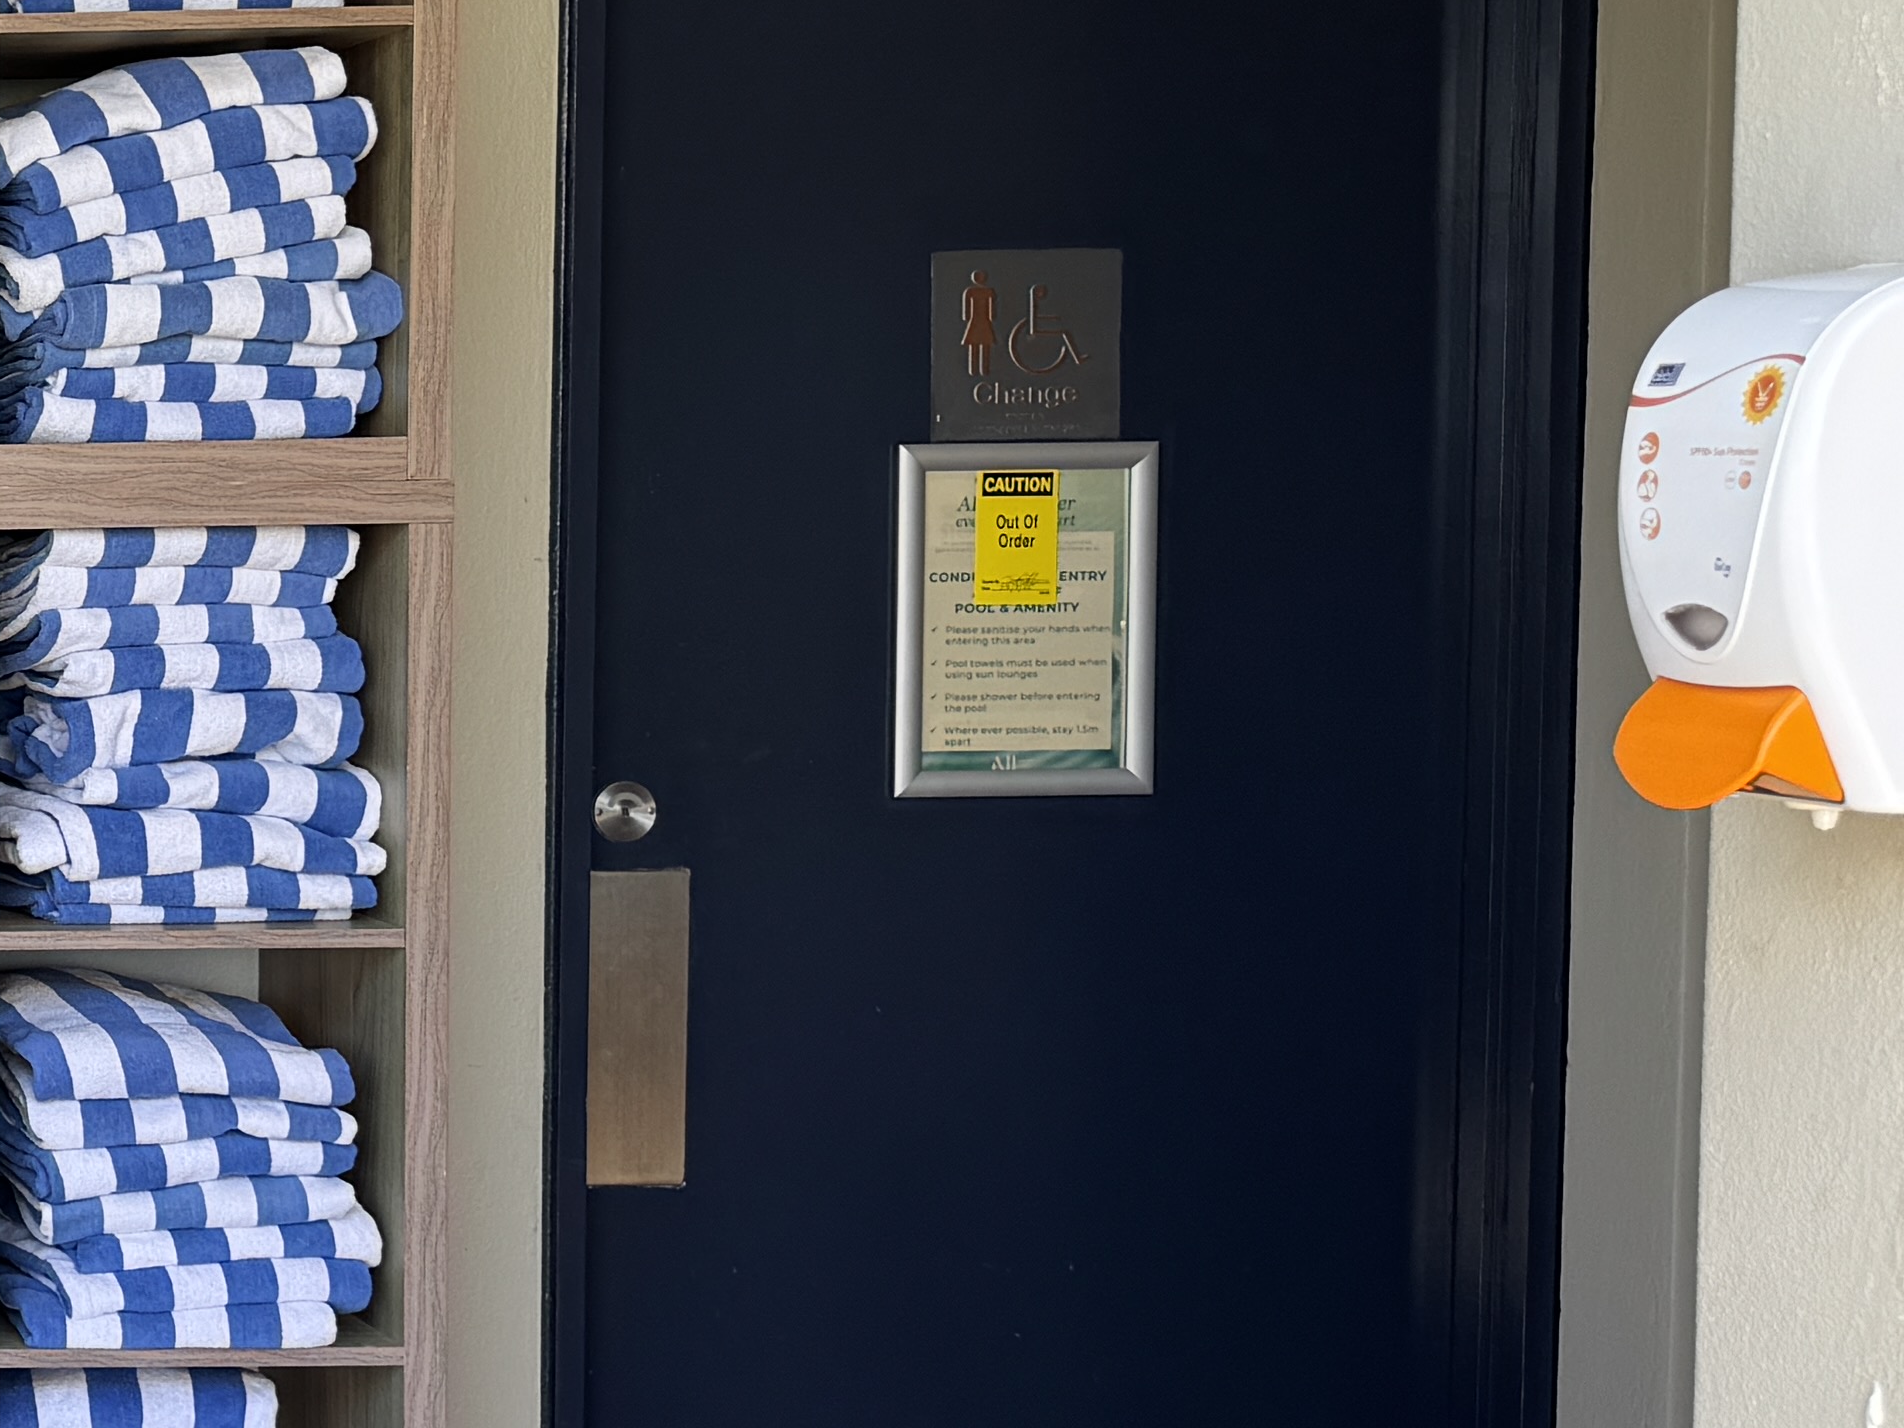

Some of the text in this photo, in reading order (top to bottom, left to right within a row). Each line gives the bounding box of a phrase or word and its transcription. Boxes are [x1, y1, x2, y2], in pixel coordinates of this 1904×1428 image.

[973, 381, 1077, 408] Change
[984, 476, 1052, 492] CAUTION
[996, 514, 1039, 529] Out Of
[998, 533, 1035, 548] Order
[1059, 570, 1107, 582] ENTRY
[945, 626, 979, 634] Please
[1022, 626, 1046, 636] your
[1048, 625, 1080, 633] hands
[945, 637, 1036, 646] entering this area
[945, 658, 1107, 668] Pool towels must be used when
[945, 670, 1038, 680] using sun lounges
[945, 692, 1100, 702] Please shower before entering
[945, 704, 987, 714] the pool
[945, 726, 979, 735] Where
[1052, 726, 1073, 735] stay
[944, 738, 971, 747] apart
